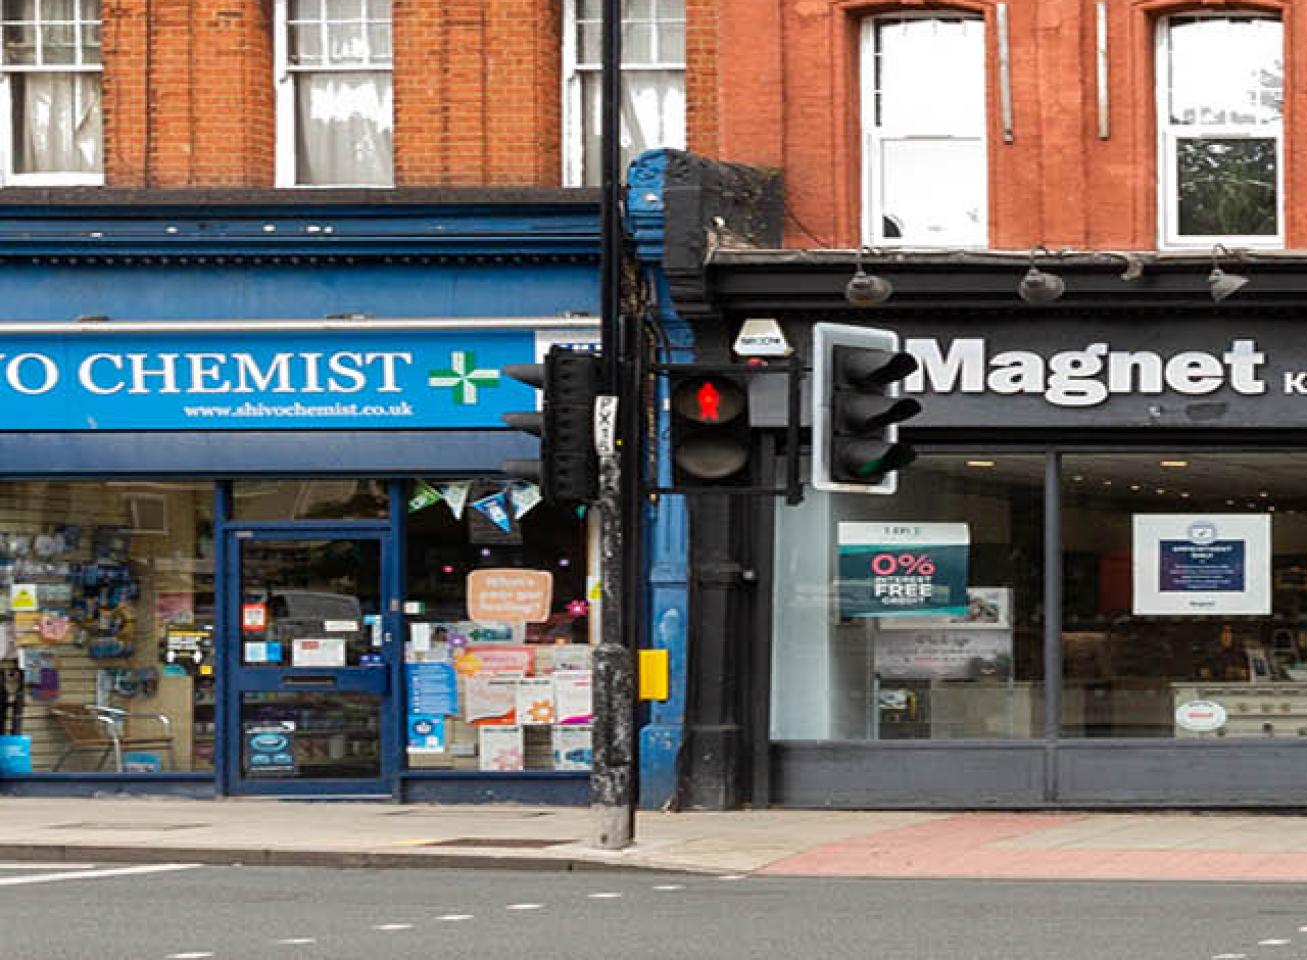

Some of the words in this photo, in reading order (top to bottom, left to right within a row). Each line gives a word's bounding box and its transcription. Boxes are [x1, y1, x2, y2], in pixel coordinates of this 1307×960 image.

[0, 352, 60, 395] O
[78, 351, 413, 395] CHEMIST
[904, 338, 1266, 406] Magnet
[184, 401, 413, 418] www.shivochemist.co.uk
[871, 553, 936, 576] 0%
[875, 584, 933, 597] FREE
